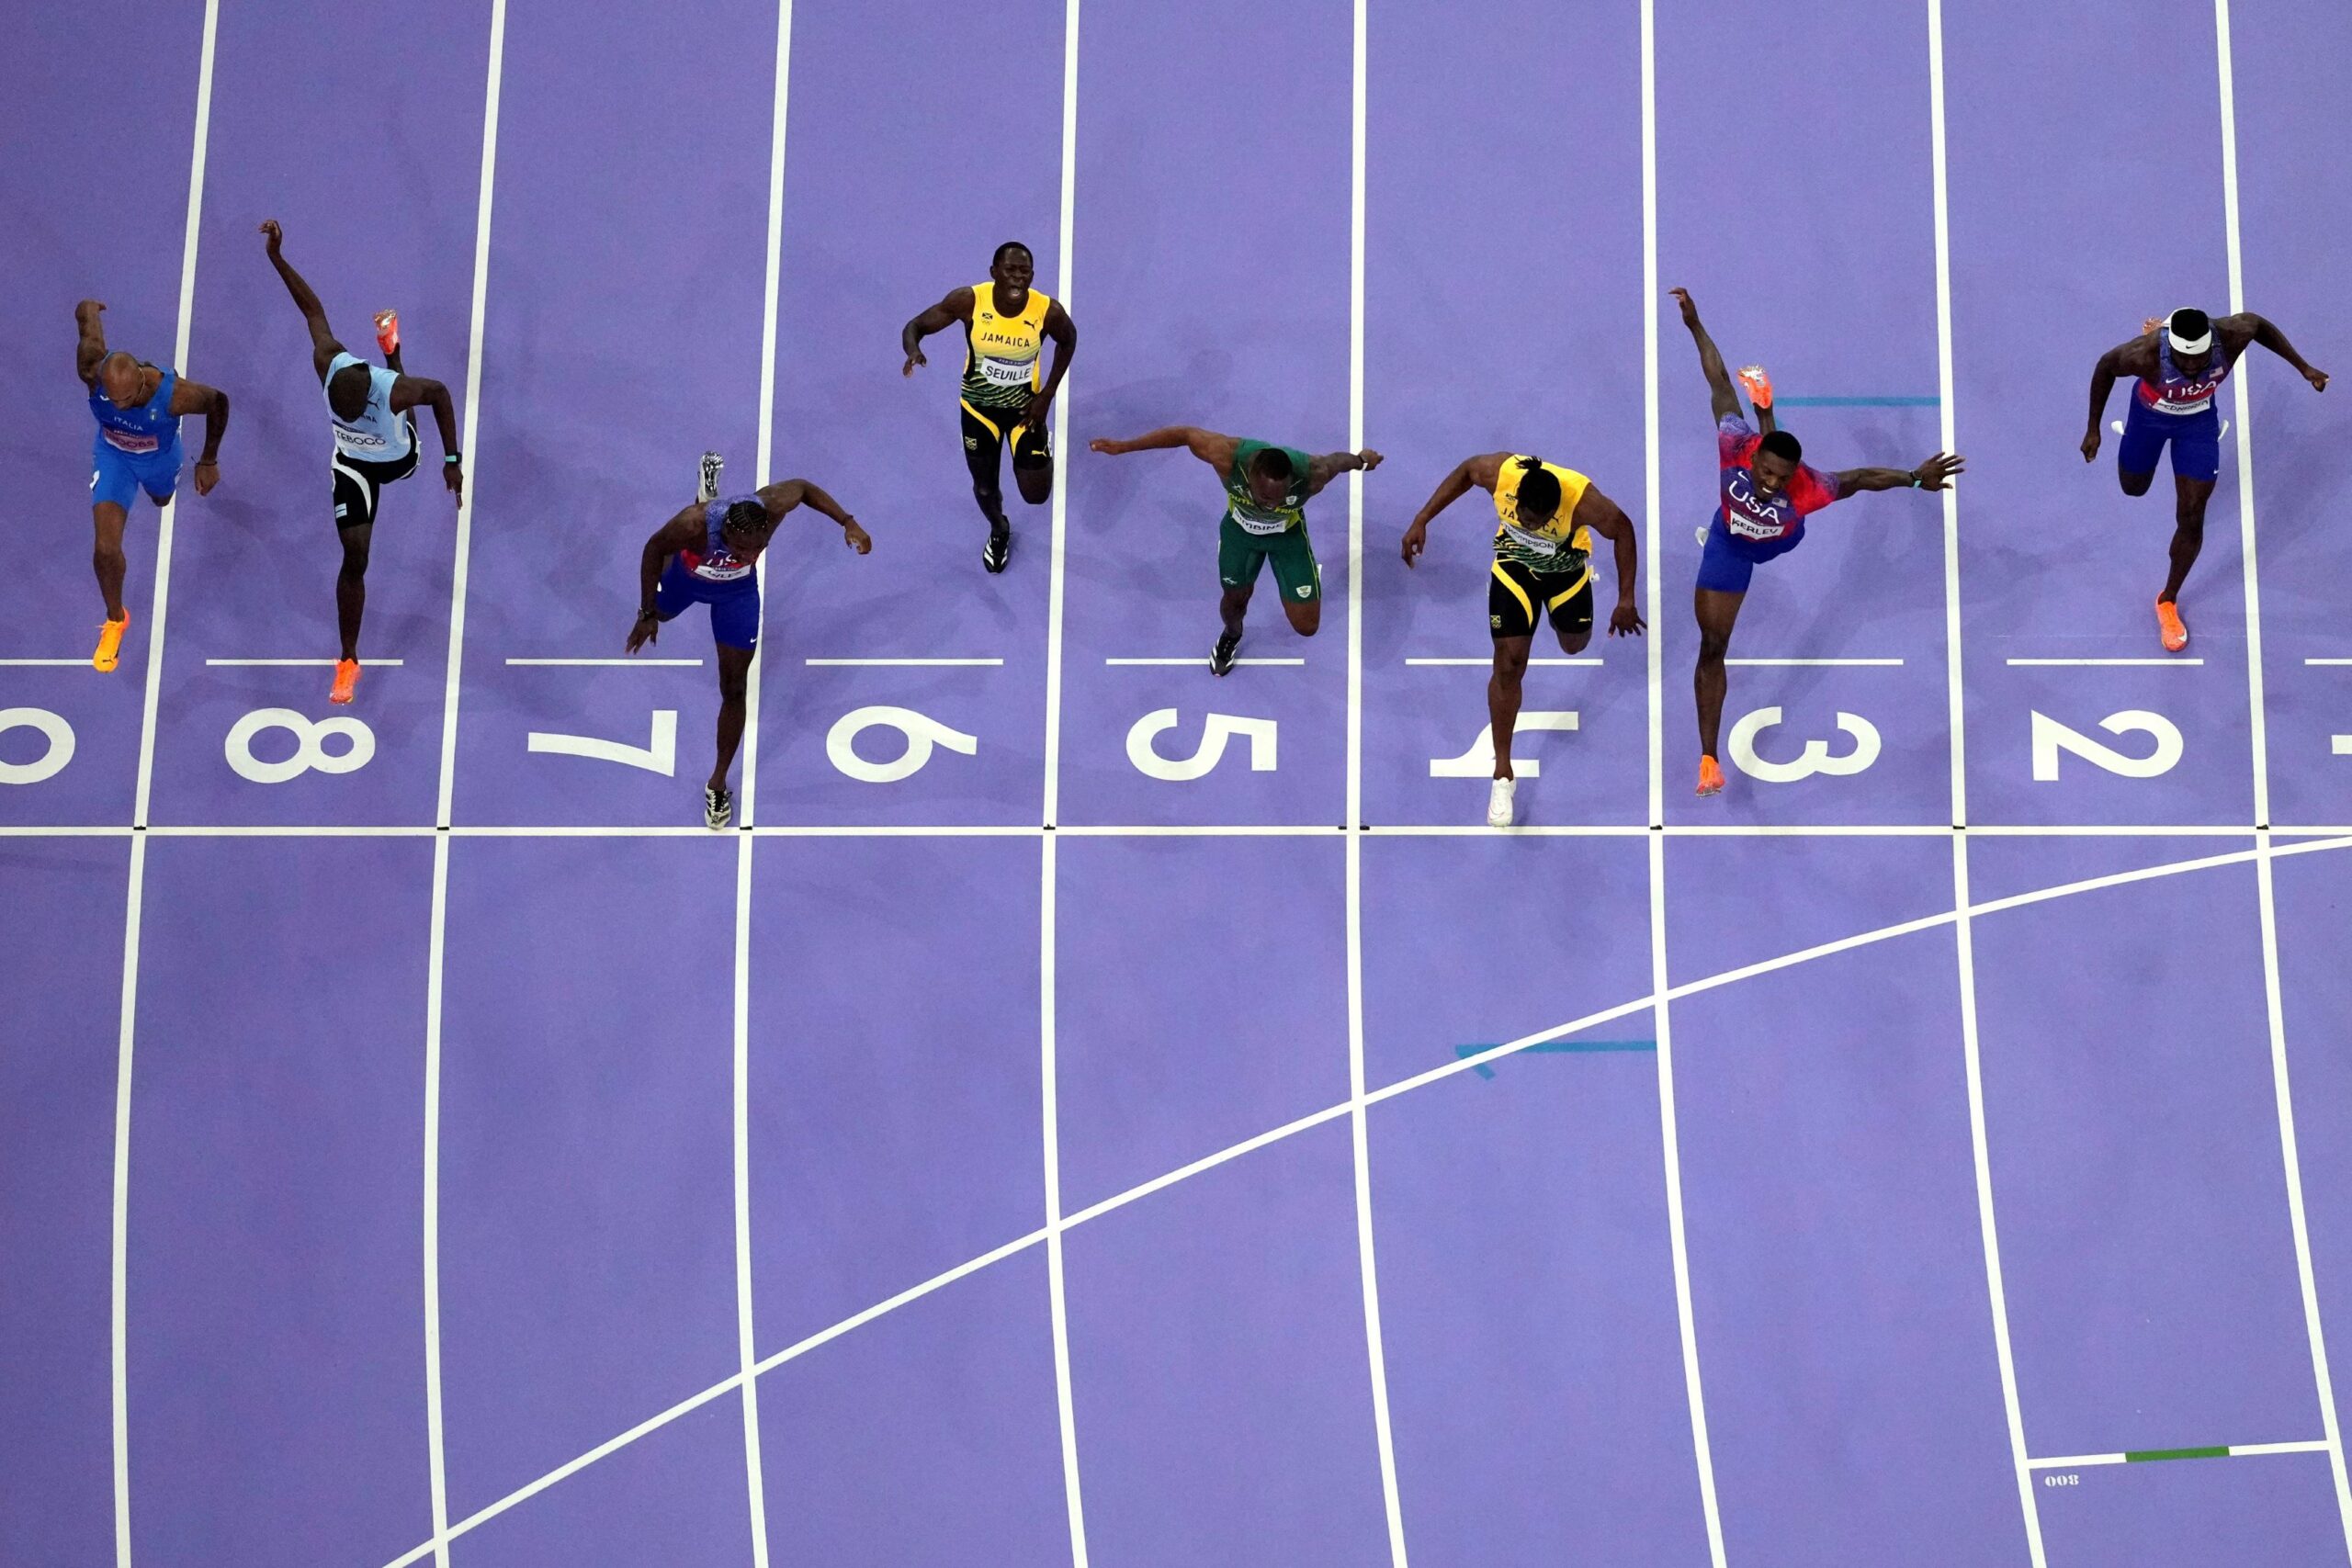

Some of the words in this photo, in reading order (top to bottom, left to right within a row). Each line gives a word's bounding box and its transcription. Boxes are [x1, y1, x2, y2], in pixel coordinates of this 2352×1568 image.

[981, 333, 1031, 347] JAMAICA
[985, 366, 1032, 380] SEVILLE
[114, 416, 143, 431] ITALIA
[335, 430, 386, 446] TEBOGO
[1503, 508, 1558, 537] JACA
[1729, 480, 1780, 524] USA
[1504, 525, 1554, 548] THOMPSON
[225, 708, 375, 783] 8
[528, 710, 677, 777] 7
[826, 706, 978, 783] 6
[1126, 708, 1277, 781] 5
[1728, 706, 1882, 783] 3
[2031, 710, 2183, 781] 2
